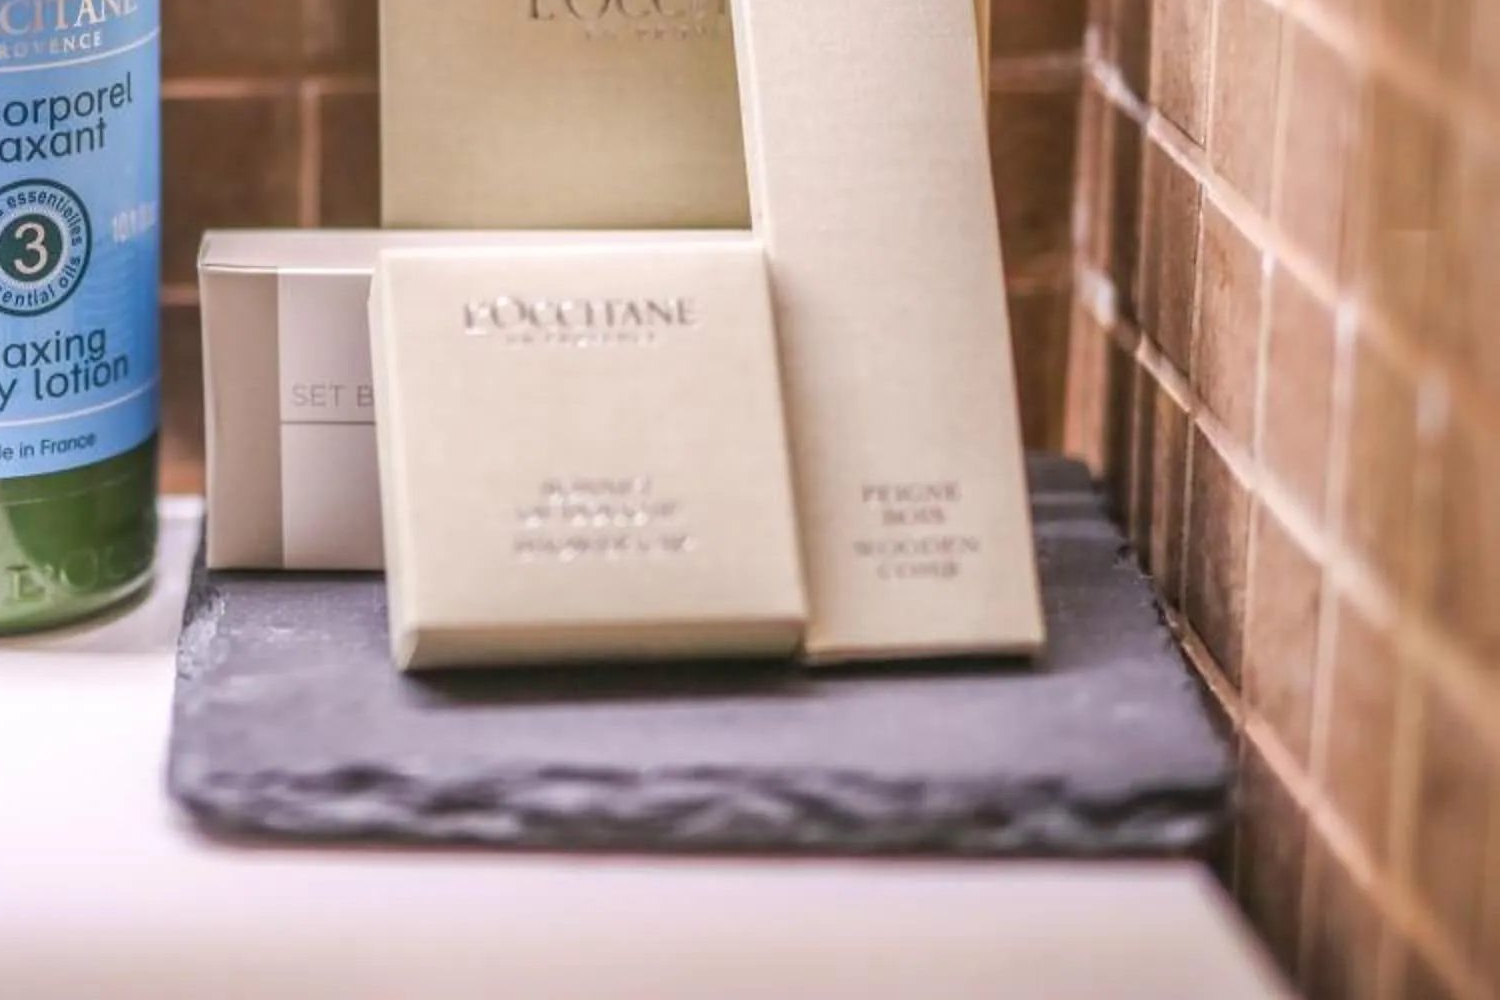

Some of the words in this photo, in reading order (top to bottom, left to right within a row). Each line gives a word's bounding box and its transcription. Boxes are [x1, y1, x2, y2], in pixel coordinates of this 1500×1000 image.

[6, 190, 83, 247] essentielles
[14, 222, 49, 275] 3
[59, 256, 81, 289] oils
[35, 353, 129, 400] lotion
[291, 383, 347, 408] SET
[19, 441, 36, 459] in
[40, 431, 97, 456] France
